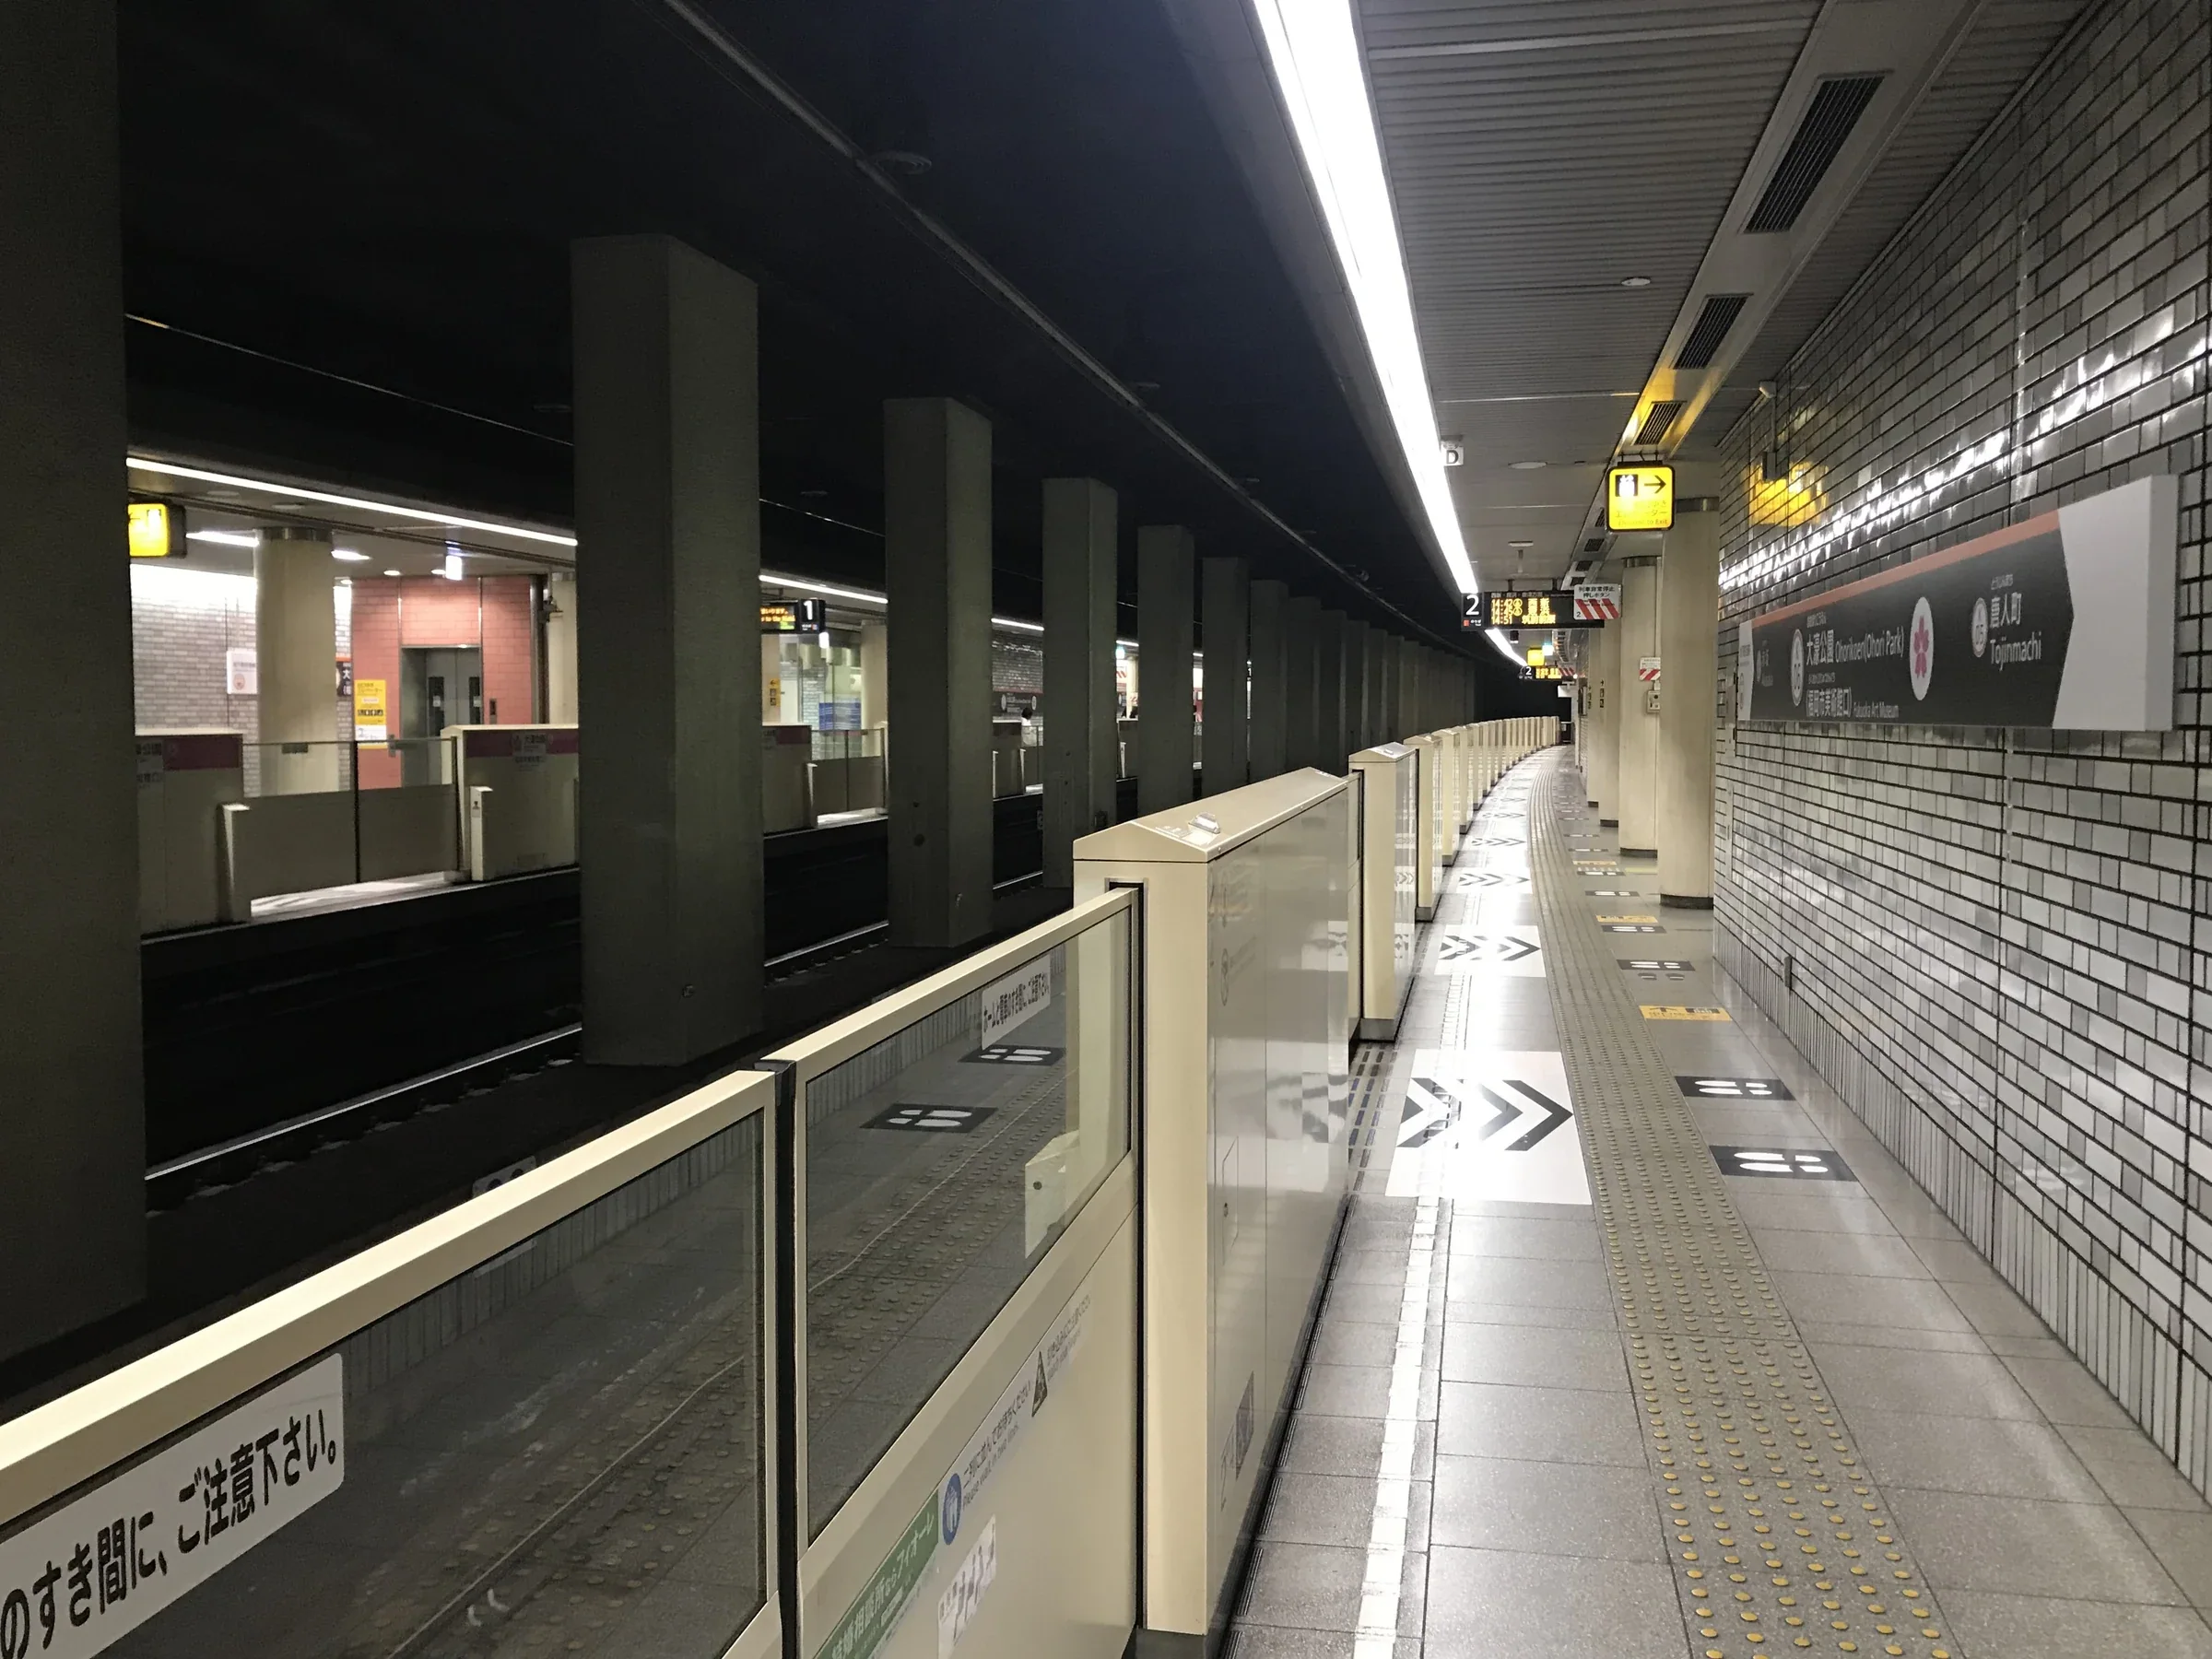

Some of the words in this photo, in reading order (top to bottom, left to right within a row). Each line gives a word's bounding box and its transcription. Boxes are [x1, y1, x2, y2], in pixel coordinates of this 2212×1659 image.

[1446, 449, 1459, 465] D
[804, 600, 813, 620] 1
[1465, 594, 1480, 616] 2
[1991, 592, 2022, 628] 唐人町
[1806, 629, 1834, 665] 大濠公園
[1886, 625, 1905, 658] Park)
[1990, 630, 2041, 671] Tojinmachi
[1, 1409, 336, 1659] のすき間に、ご注意下さい。
